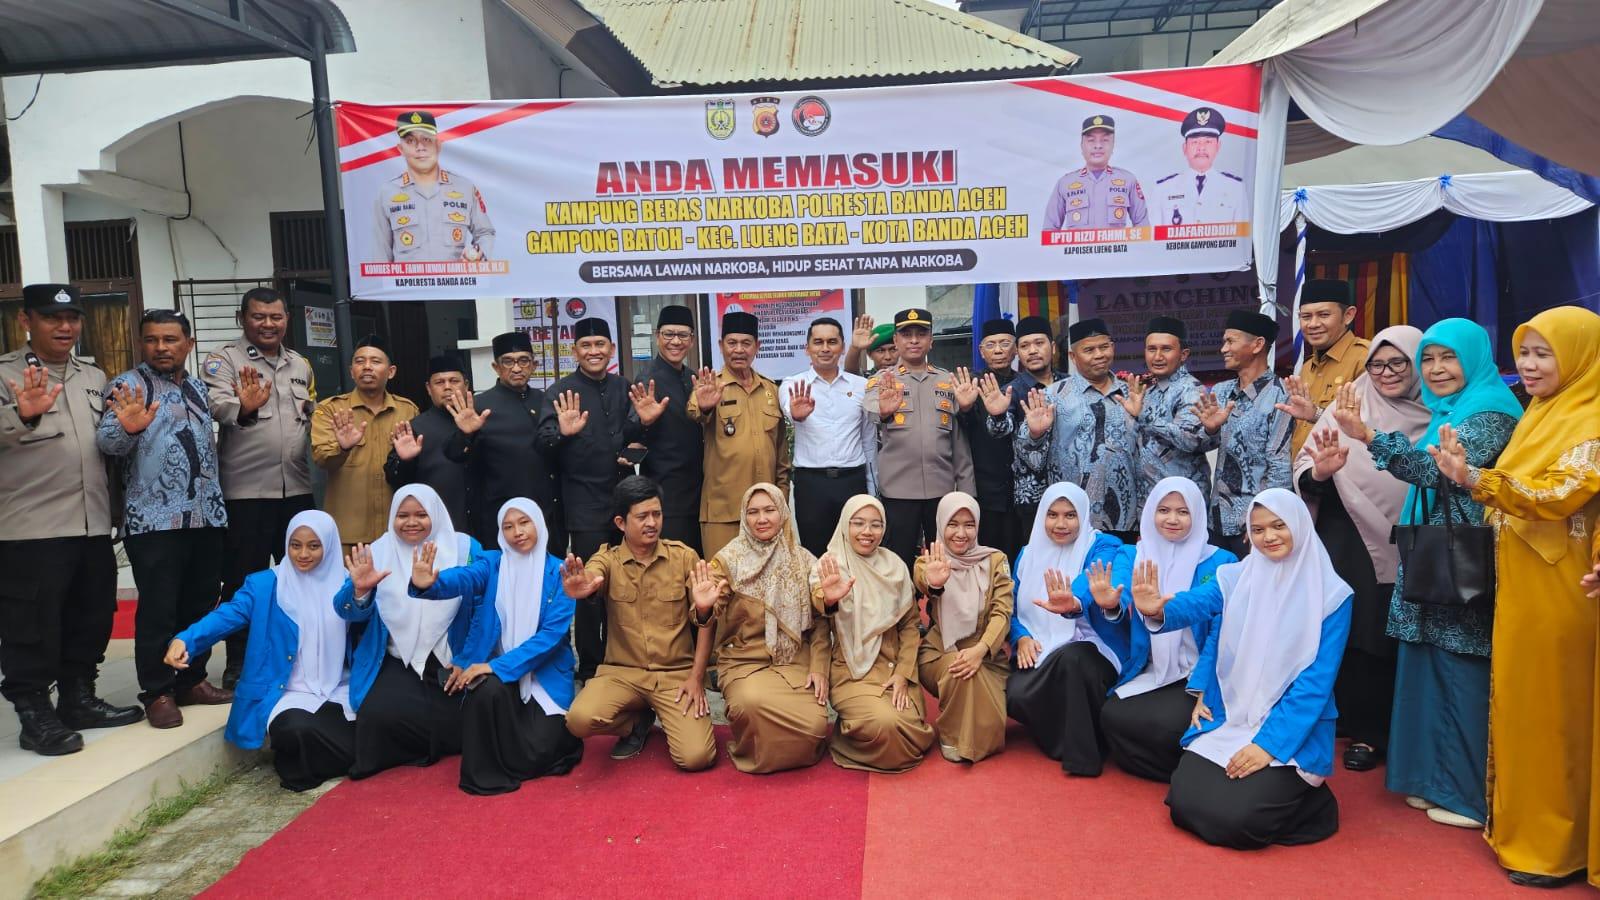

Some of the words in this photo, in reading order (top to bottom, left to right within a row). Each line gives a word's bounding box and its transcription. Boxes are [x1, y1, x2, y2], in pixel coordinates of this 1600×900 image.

[595, 159, 716, 197] ANDA
[722, 150, 957, 194] MEMASUKI
[545, 200, 638, 225] KAMPUNG
[641, 197, 702, 223] BEBAS
[705, 195, 794, 221] NARKOBA
[797, 192, 889, 218] POLRESTA
[890, 189, 955, 215] BANDA
[957, 186, 1007, 212] ACEH
[526, 229, 619, 254] GAMPONG
[621, 227, 684, 252] BATOH
[685, 236, 695, 244] -
[696, 225, 738, 250] KEC.
[740, 223, 799, 248] LUENG
[801, 221, 850, 247] BATA
[862, 219, 910, 245] KOTA
[913, 217, 977, 243] BANDA
[979, 214, 1029, 240] ACEH
[1050, 231, 1072, 244] IPTU
[1130, 228, 1143, 241] SE
[1167, 224, 1237, 239] DJAFARUDDIN
[1064, 246, 1094, 255] KAPOLSEK
[1094, 245, 1114, 254] LUENG
[592, 265, 653, 278] BERSAMA
[655, 263, 702, 277] LAWAN
[704, 260, 770, 276] NARKOBA,
[772, 259, 812, 273] HIDUP
[814, 257, 855, 271] SEHAT
[857, 256, 899, 270] TANPA
[901, 254, 964, 268] NARKOBA
[395, 278, 435, 287] KAPOLRESTA
[436, 277, 459, 286] BANDA
[459, 276, 477, 286] ACEH
